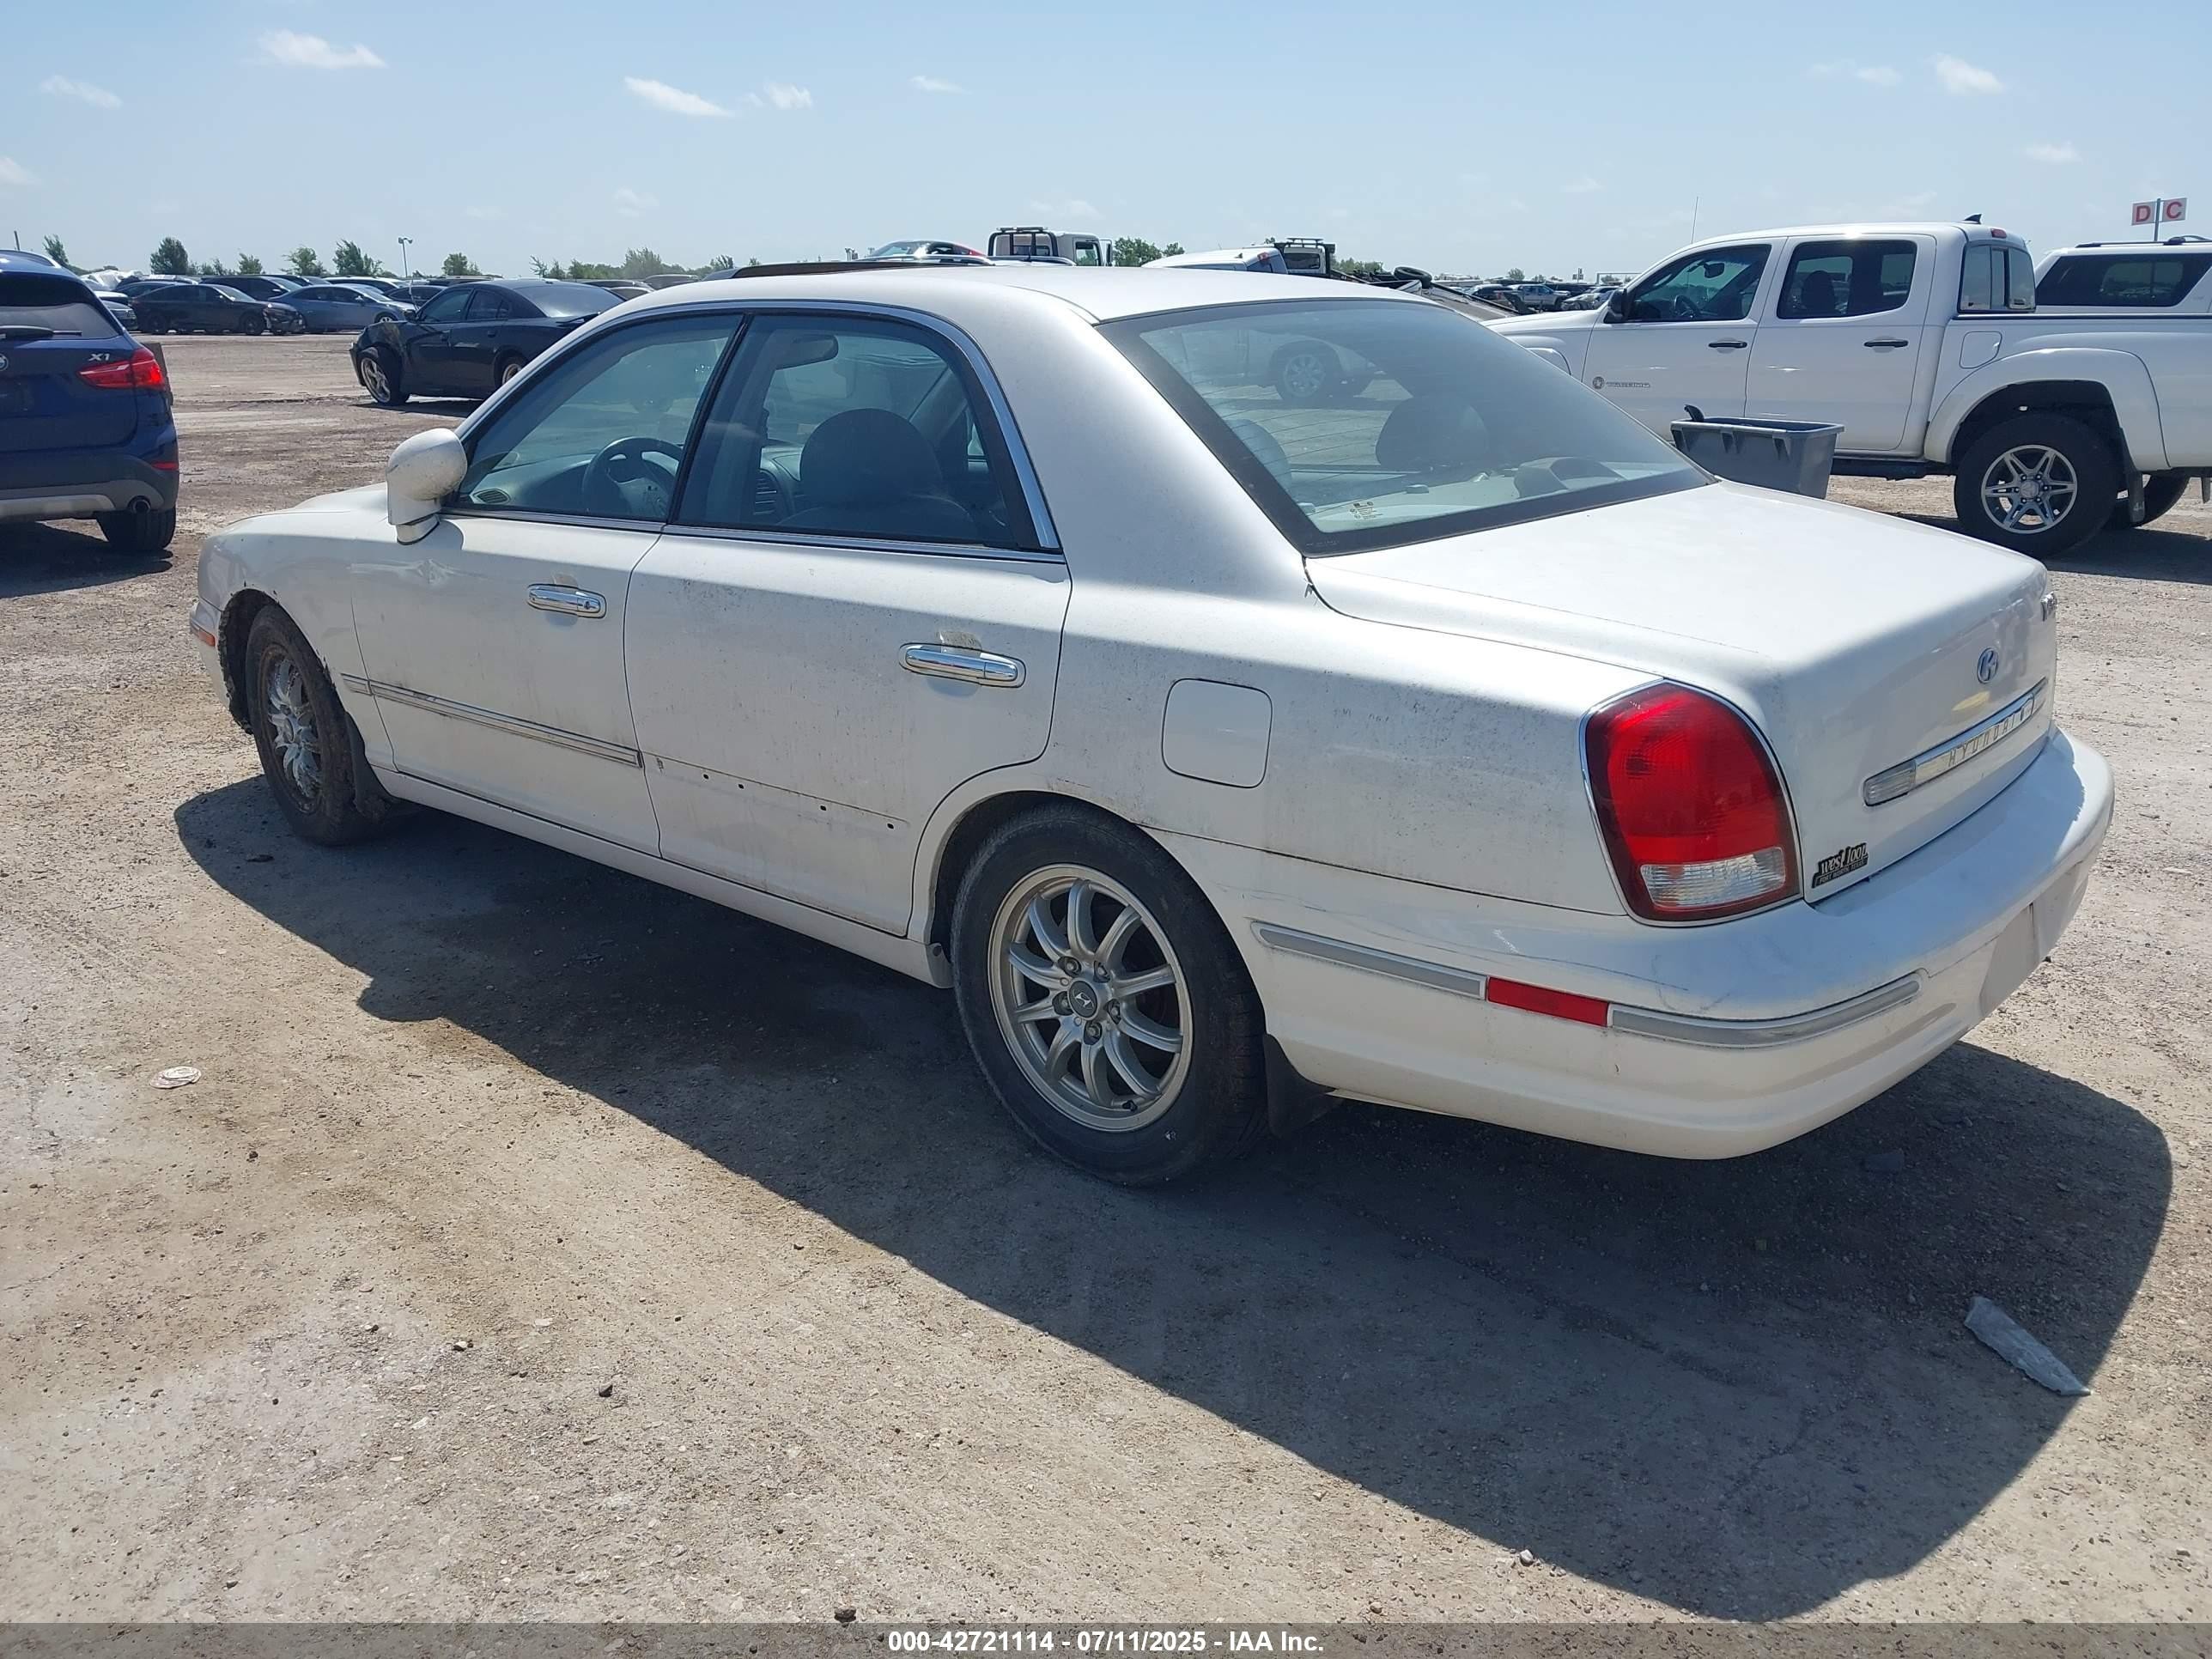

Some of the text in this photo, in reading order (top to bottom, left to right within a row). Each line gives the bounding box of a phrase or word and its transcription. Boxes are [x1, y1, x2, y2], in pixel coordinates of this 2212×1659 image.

[2136, 205, 2151, 222] D
[2166, 201, 2183, 220] C
[88, 353, 110, 362] X1
[1948, 714, 2015, 767] HYUNDAI
